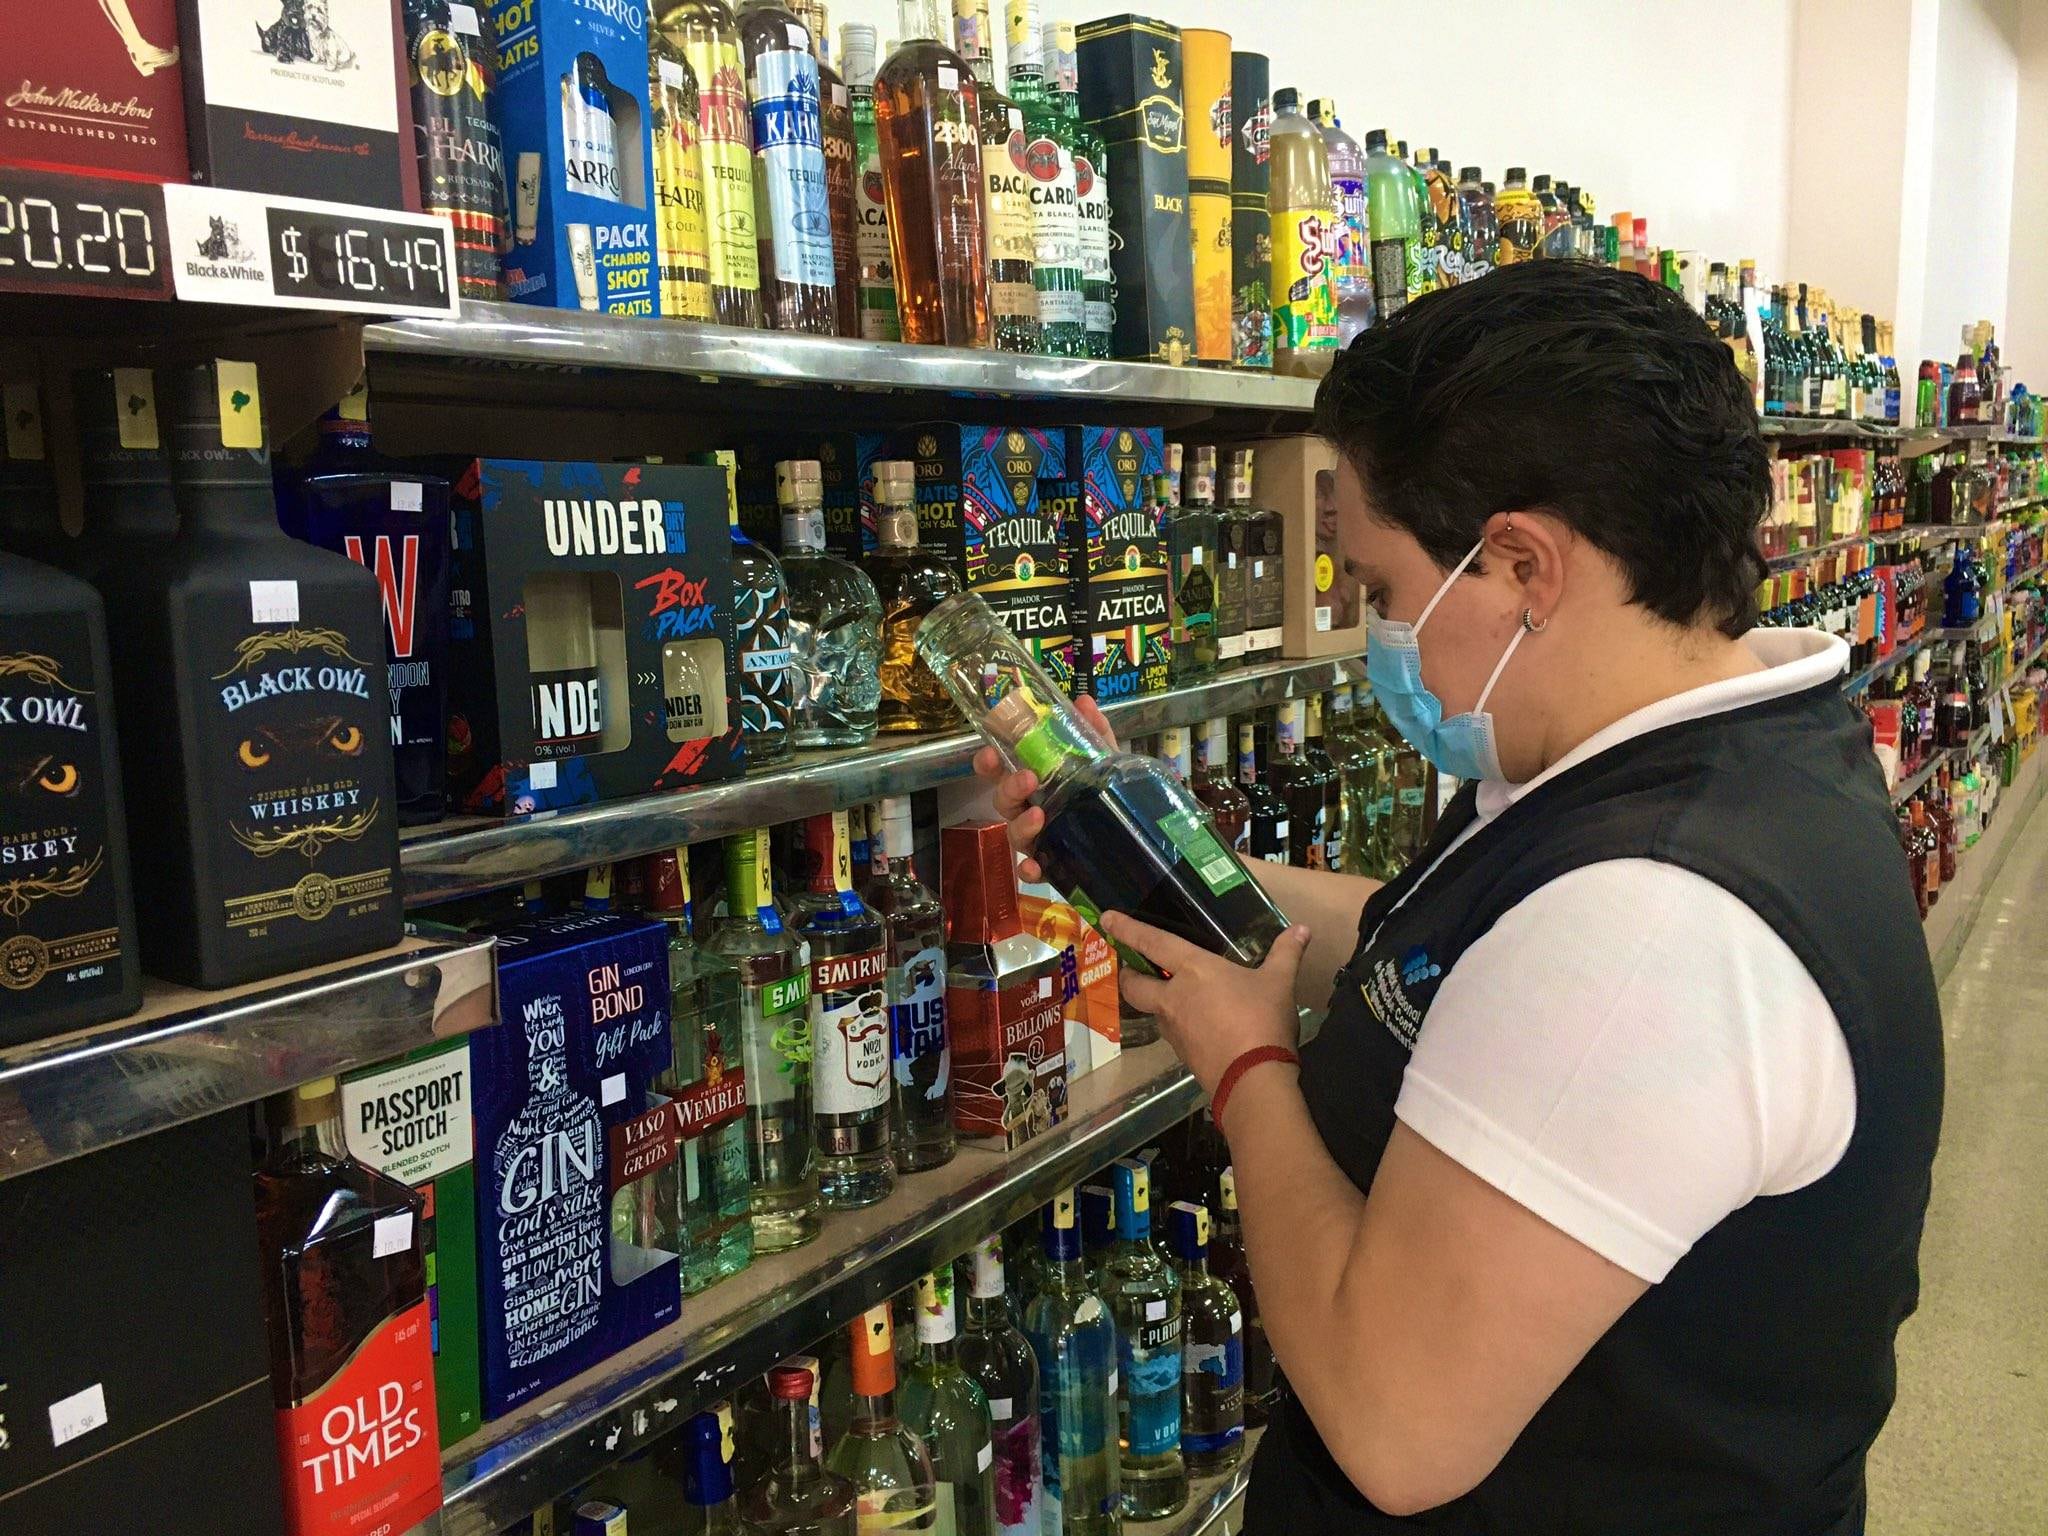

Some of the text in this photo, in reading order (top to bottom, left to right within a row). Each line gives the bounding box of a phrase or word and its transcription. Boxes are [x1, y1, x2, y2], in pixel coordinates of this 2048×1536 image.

[6, 79, 57, 107] John
[57, 87, 110, 114] Walker
[119, 97, 154, 119] Sons
[7, 117, 157, 146] ESTABLISHED 1820
[934, 120, 977, 146] 2300
[1154, 195, 1183, 215] BLACK
[596, 224, 649, 250] PACK
[187, 262, 265, 281] Black&White
[281, 226, 446, 293] $ 16.49
[603, 250, 650, 267] CHARRO
[607, 268, 649, 290] SHOT
[608, 298, 652, 315] GRATIS
[915, 464, 943, 478] ORO
[1007, 460, 1032, 474] ORO
[1117, 459, 1136, 472] ORO
[543, 499, 667, 556] UNDER
[940, 518, 957, 529] SAL
[985, 516, 1056, 549] TEQUILA
[1102, 512, 1157, 542] TEQUILA
[657, 604, 717, 640] PACK
[1097, 594, 1165, 622] AZTECA
[1095, 671, 1139, 698] SHOT
[1146, 664, 1168, 680] LIMON
[1154, 679, 1168, 691] SAL
[221, 666, 370, 713] BLACK OWL
[22, 697, 87, 732] OWL
[250, 789, 360, 821] WHISKEY
[43, 826, 68, 839] OLD
[3, 836, 78, 865] SKEY
[588, 963, 620, 995] GIN
[1081, 960, 1112, 987] GRATIS
[523, 998, 562, 1023] When
[592, 985, 643, 1024] BOND
[596, 1010, 662, 1069] Gift Pack
[1006, 1004, 1061, 1047] BELLOWS
[526, 1025, 565, 1058] YOU
[539, 1057, 561, 1092] &
[856, 1054, 886, 1070] VODKA
[361, 1070, 463, 1134] PASSPORT
[700, 1086, 721, 1099] PRIDE
[382, 1110, 447, 1157] SCOTCH
[507, 1118, 543, 1143] Night
[625, 1109, 666, 1146] VASO
[382, 1143, 451, 1174] BLENDED SCOTCH
[402, 1160, 433, 1179] WHISKY
[501, 1119, 595, 1214] GIN
[623, 1142, 668, 1178] GRATIS
[499, 1183, 603, 1242] God's sake
[500, 1239, 525, 1258] Give
[501, 1214, 601, 1273] gin martini tonic
[557, 1227, 603, 1267] DRINK
[504, 1248, 602, 1310] GinBond more
[505, 1266, 602, 1330] HOME GIN
[515, 1320, 544, 1337] where
[545, 1311, 561, 1326] the
[508, 1337, 526, 1355] GIN
[321, 1381, 404, 1446] OLD
[302, 1407, 422, 1495] TIMES
